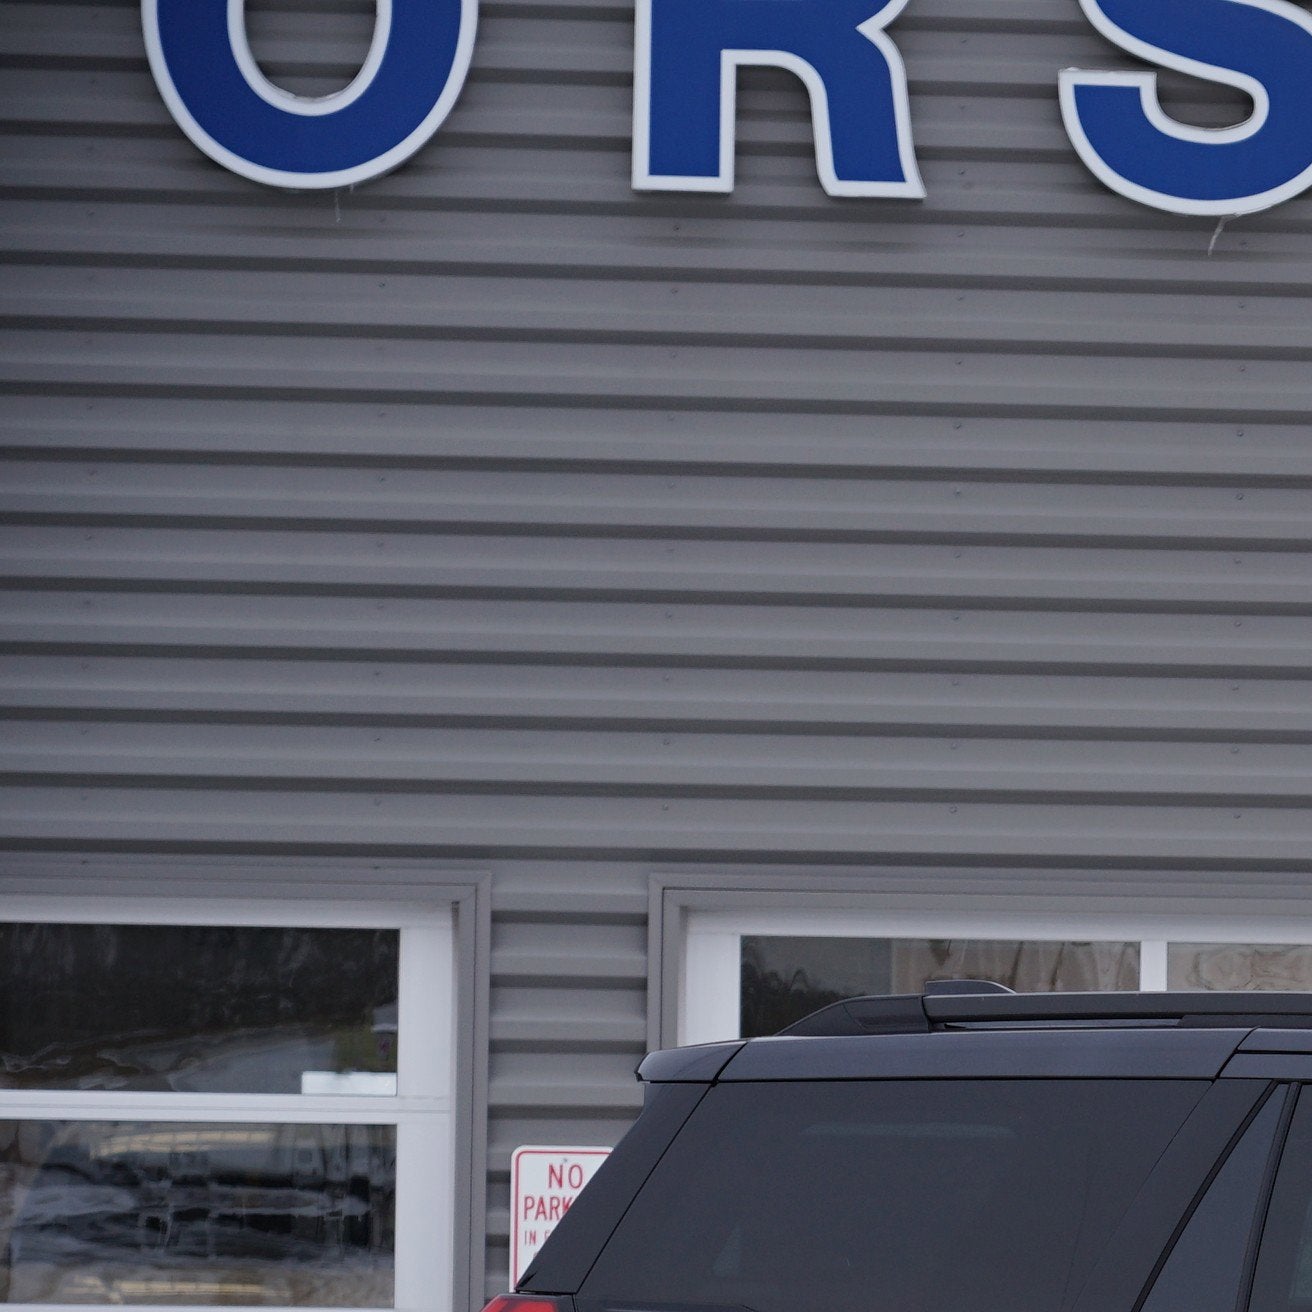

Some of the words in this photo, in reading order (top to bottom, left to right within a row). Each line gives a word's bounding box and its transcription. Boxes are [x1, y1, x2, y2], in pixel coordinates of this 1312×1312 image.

[548, 1164, 583, 1189] NO
[524, 1196, 572, 1220] PARK
[524, 1230, 537, 1246] IN
